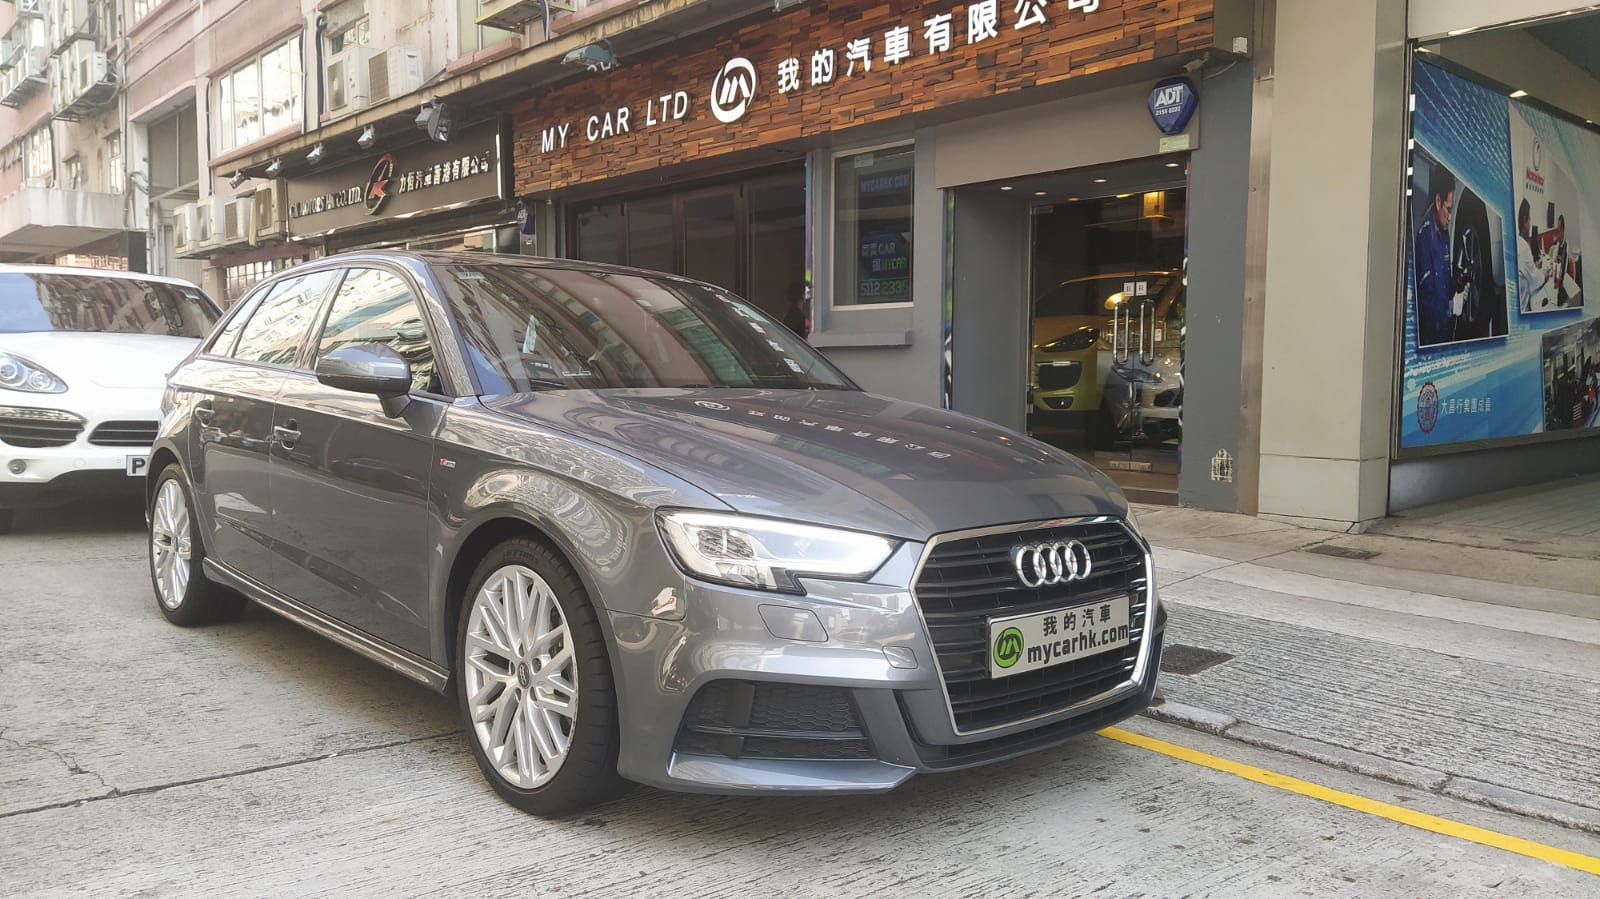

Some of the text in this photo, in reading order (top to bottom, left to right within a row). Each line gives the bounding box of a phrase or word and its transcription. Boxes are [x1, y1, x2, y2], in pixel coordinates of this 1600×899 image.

[1154, 86, 1184, 107] ADT
[541, 91, 688, 153] MY CAR LTD
[1042, 604, 1111, 637] 我的汽車
[1027, 624, 1129, 664] mycarhk.com
